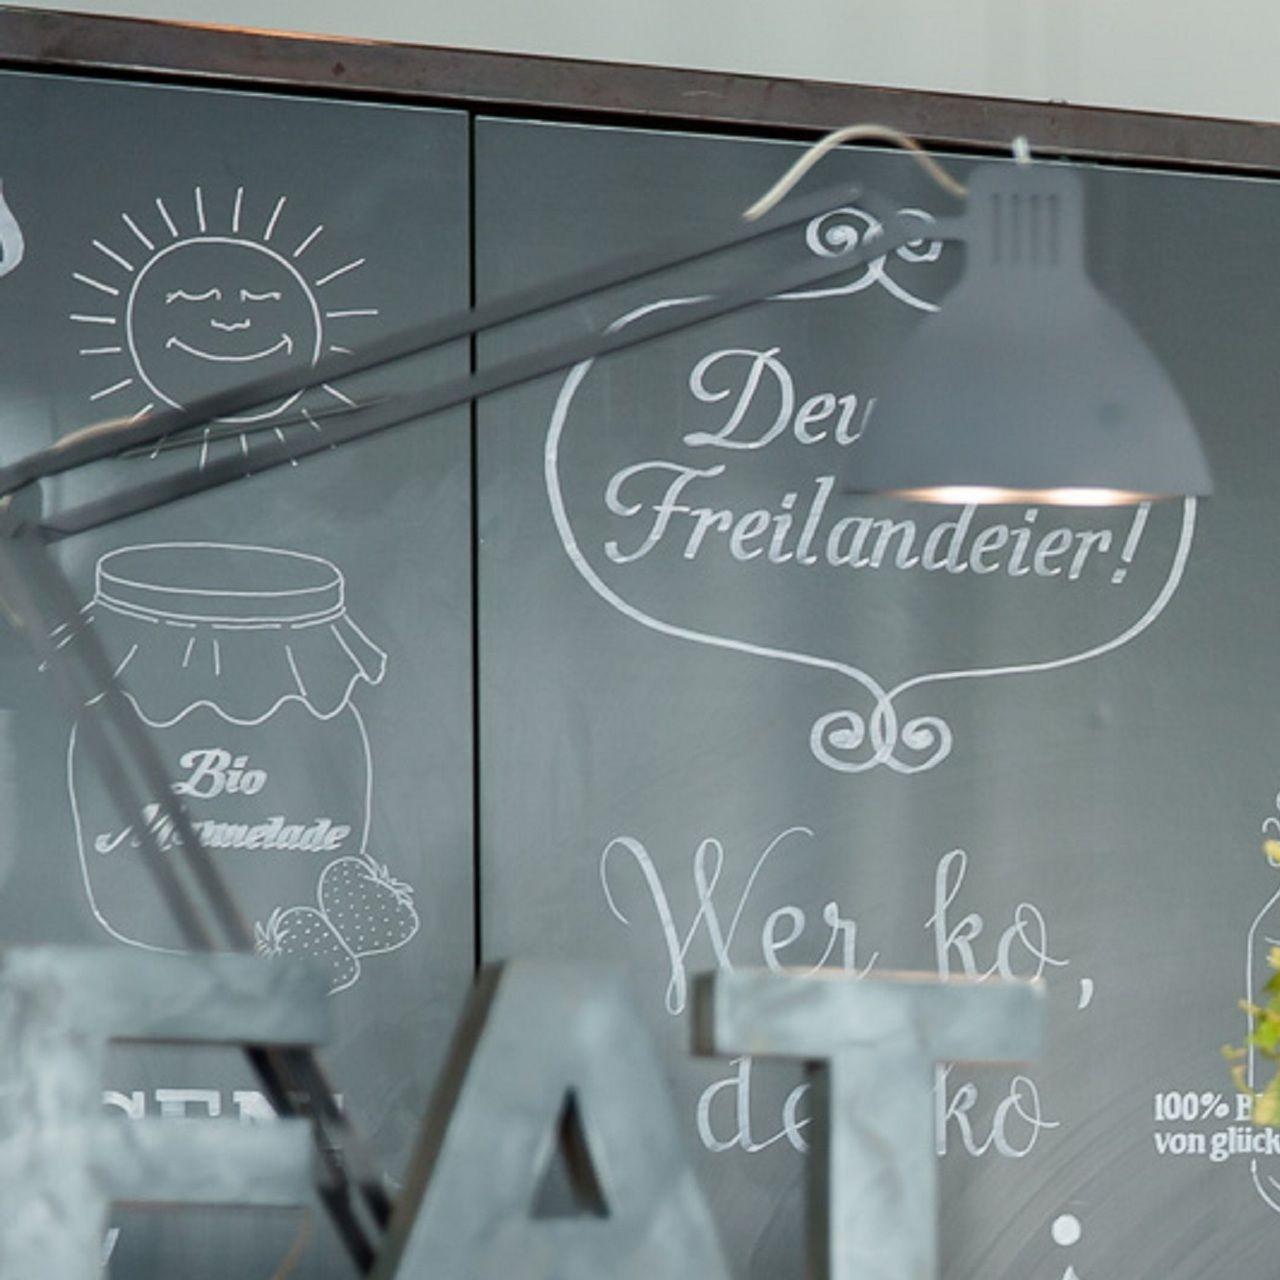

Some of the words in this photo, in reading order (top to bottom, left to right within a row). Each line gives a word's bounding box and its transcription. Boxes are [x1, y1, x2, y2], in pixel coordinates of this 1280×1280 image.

[604, 460, 1152, 584] Freilandeier!
[170, 748, 268, 799] Bio
[601, 827, 880, 1015] Wer
[697, 1056, 812, 1154] de
[1154, 1091, 1230, 1122] 100%
[1154, 1130, 1206, 1155] von
